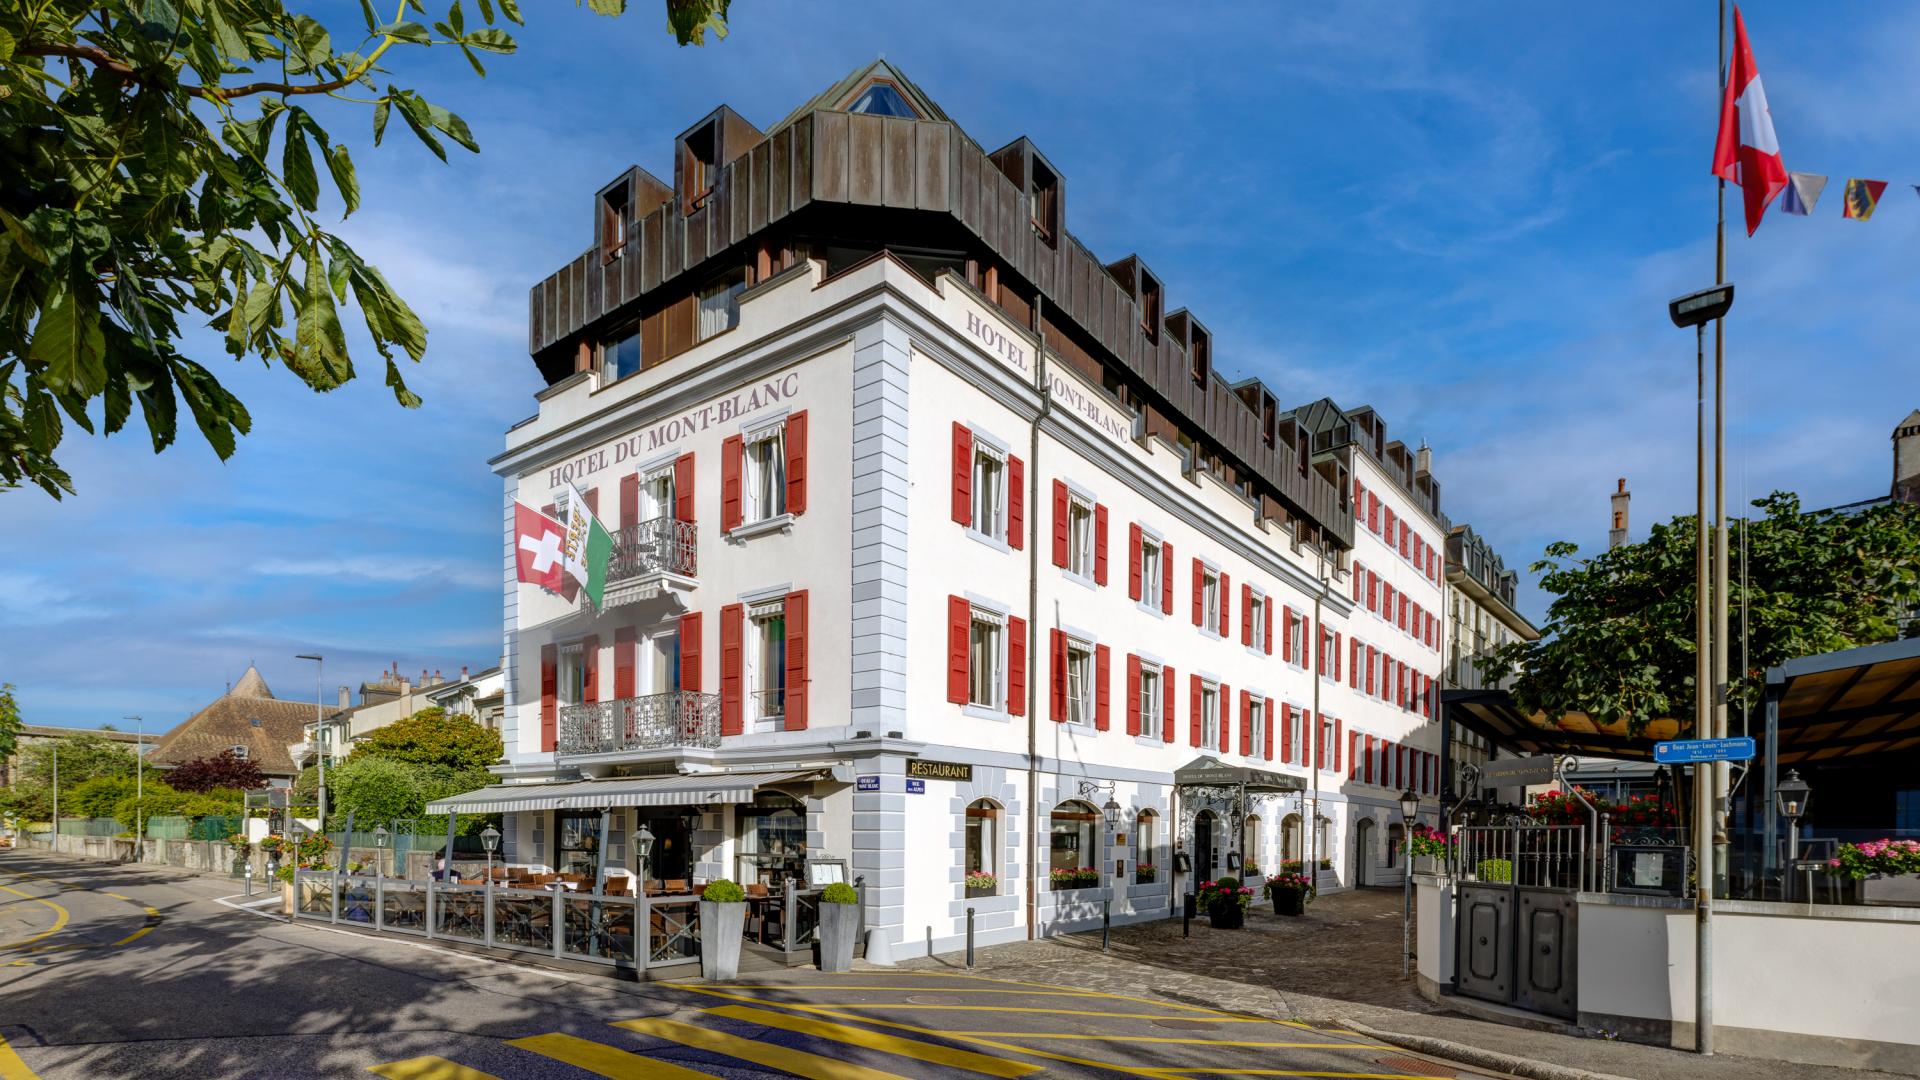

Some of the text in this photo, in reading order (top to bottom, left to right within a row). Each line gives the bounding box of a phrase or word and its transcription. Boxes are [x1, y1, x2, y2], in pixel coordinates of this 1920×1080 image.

[966, 310, 1028, 372] HOTEL
[548, 372, 799, 490] HOTEL DU MONT-BLANC
[911, 762, 969, 778] RESTAURANT
